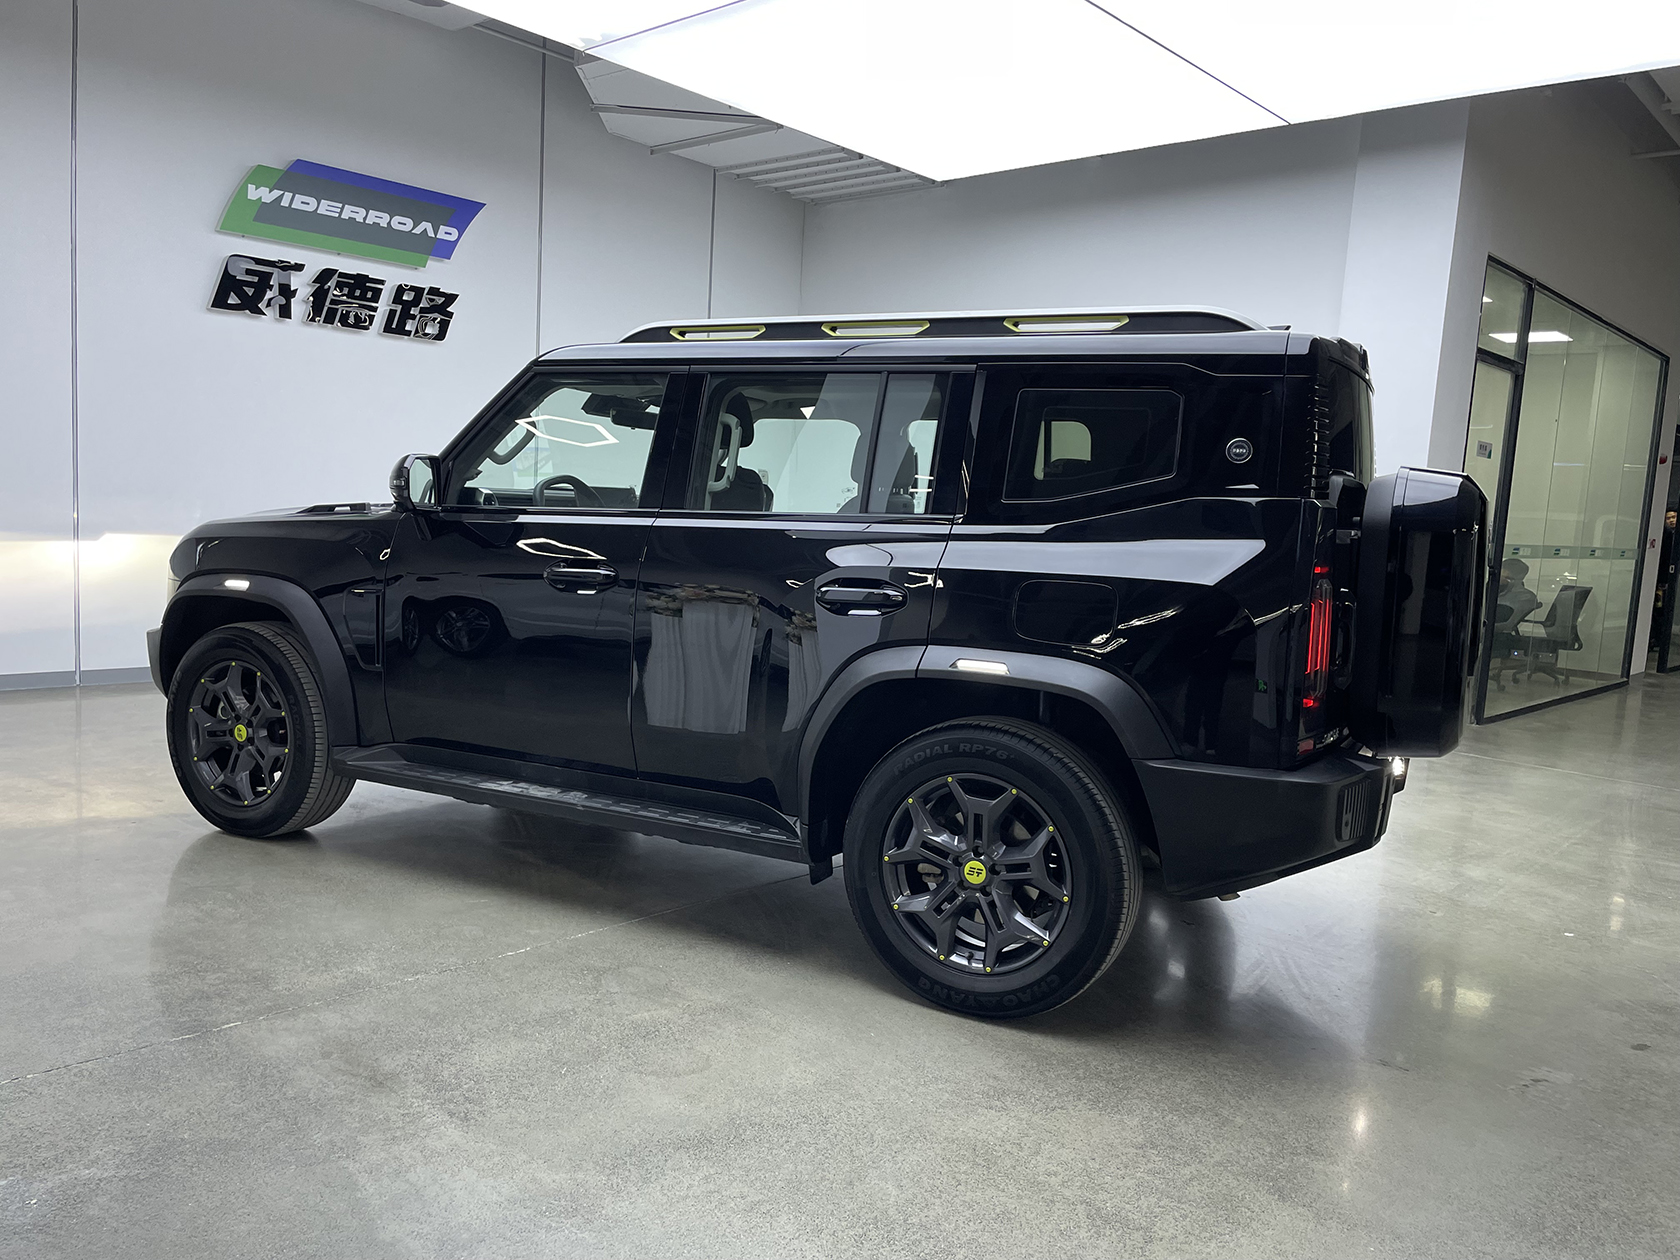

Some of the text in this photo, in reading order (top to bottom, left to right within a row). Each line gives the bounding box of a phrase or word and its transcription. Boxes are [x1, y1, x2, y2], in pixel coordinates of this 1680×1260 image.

[247, 184, 459, 242] WIDERROAD
[207, 253, 460, 342] 威德路
[893, 743, 953, 776] RADIAL
